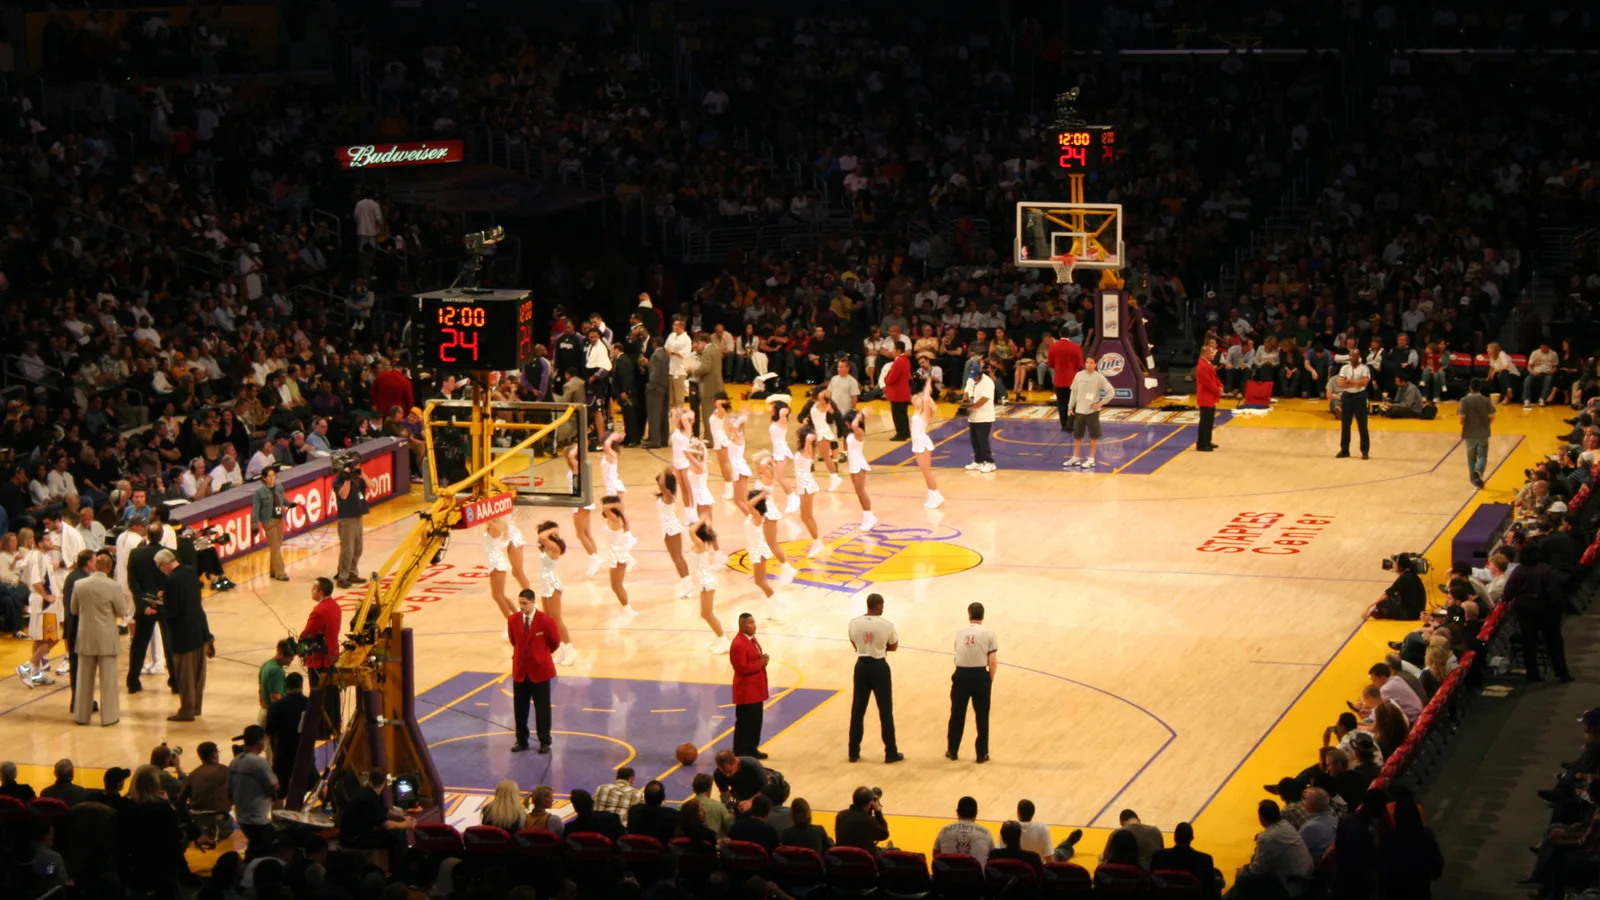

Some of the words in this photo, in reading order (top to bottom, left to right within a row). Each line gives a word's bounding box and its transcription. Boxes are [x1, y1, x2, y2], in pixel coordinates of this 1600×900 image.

[1059, 132, 1090, 146] 12:00
[347, 144, 449, 167] Budweiser
[1059, 146, 1086, 168] 24
[438, 306, 486, 327] 12:00
[440, 328, 479, 362] 24
[476, 497, 512, 520] AAA.com
[1196, 511, 1285, 554] STAPLES
[1251, 513, 1336, 555] Center
[965, 635, 976, 646] 24
